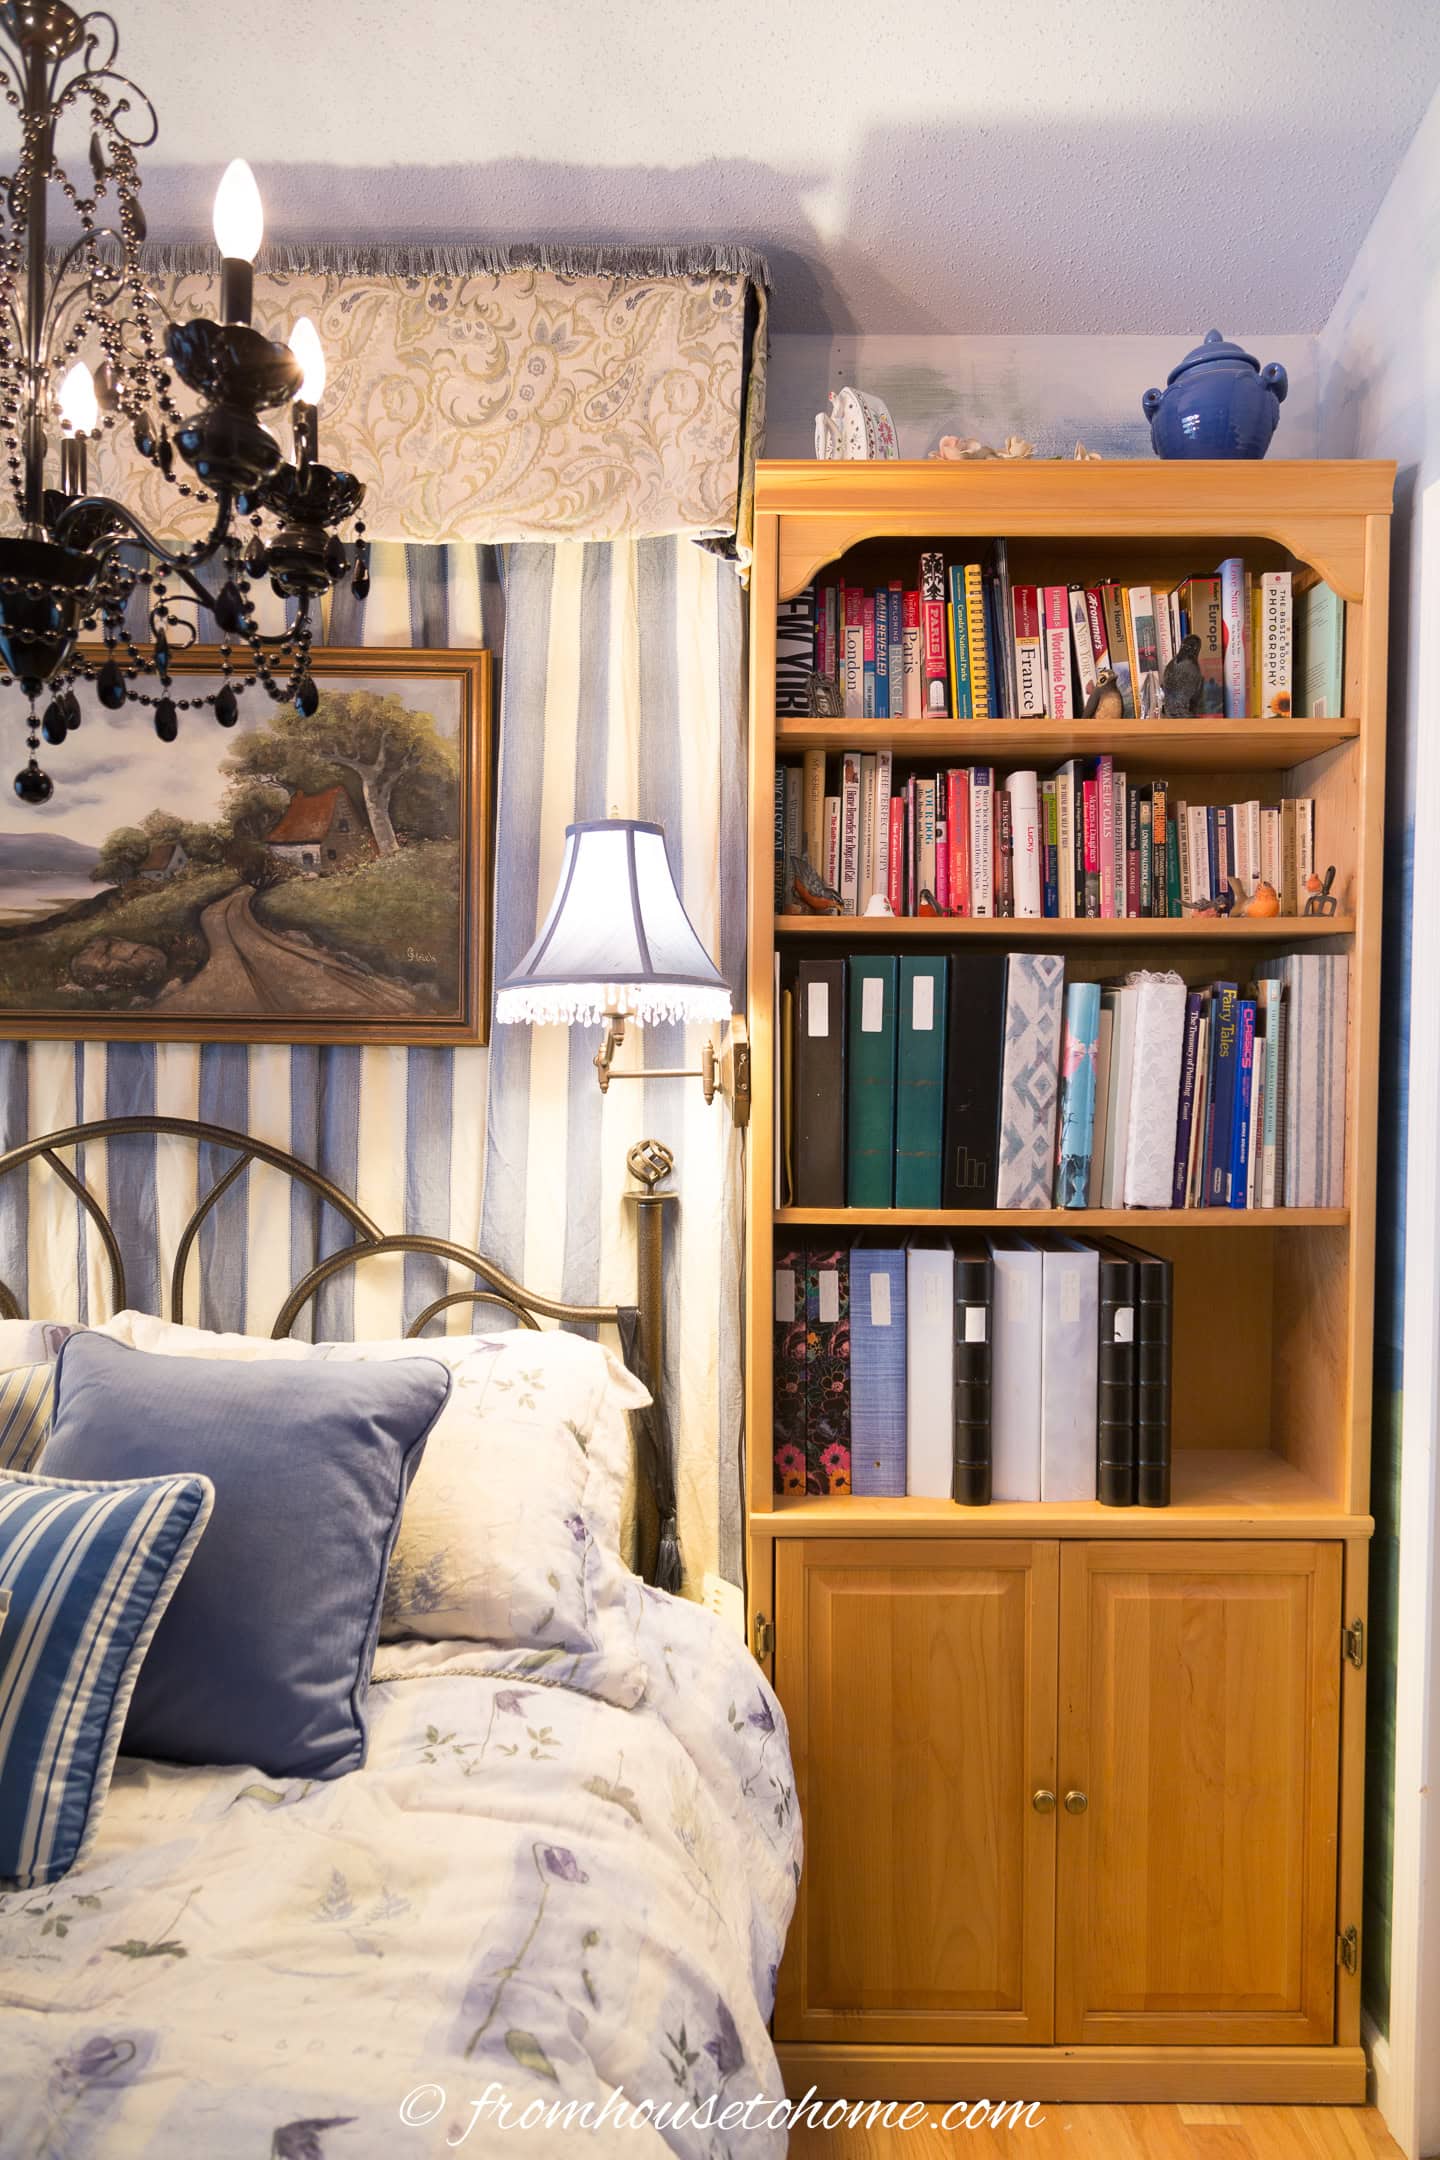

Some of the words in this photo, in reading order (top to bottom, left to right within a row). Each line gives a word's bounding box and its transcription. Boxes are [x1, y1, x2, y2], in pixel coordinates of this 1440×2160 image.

[1230, 564, 1241, 587] Love
[876, 592, 887, 622] MAUI
[1230, 590, 1241, 618] Smart
[1279, 590, 1287, 607] THE
[863, 608, 874, 650] Jamaica
[892, 594, 900, 642] EXPLORING
[930, 608, 941, 654] PARIS
[1088, 600, 1104, 650] Frommer's
[1207, 604, 1220, 652] Europe
[1279, 611, 1287, 642] BASIC
[876, 623, 887, 676] REVEALED
[1077, 624, 1089, 646] NEW
[1268, 588, 1278, 687] PHOTOGRAPHY
[846, 629, 860, 690] London
[903, 631, 919, 674] Paris
[1051, 631, 1064, 682] Worldwide
[1079, 649, 1092, 677] YORK
[1279, 645, 1287, 671] BOOK
[890, 647, 903, 704] FRANCE
[1021, 649, 1036, 710] France
[1053, 683, 1066, 719] Cruises
[880, 767, 890, 789] THE
[1102, 762, 1112, 806] WAKE-UP
[846, 790, 857, 807] Home
[925, 789, 934, 819] YOUR
[1088, 794, 1097, 820] Mothers
[845, 807, 857, 835] Remedies
[880, 792, 890, 837] PERFECT
[1103, 808, 1113, 838] CALLS
[1114, 803, 1123, 826] HIGHLY
[1153, 791, 1166, 844] SUPERLEARNING
[845, 835, 856, 844] for
[924, 821, 933, 846] DOG
[1087, 828, 1097, 864] Daughters
[1114, 827, 1123, 863] EFFECTIVE
[843, 844, 856, 858] Dogs
[844, 858, 856, 870] and
[879, 840, 889, 873] PUPPY
[844, 870, 855, 883] Cats
[1115, 863, 1123, 888] PEOPLE
[1190, 1011, 1199, 1025] The
[1217, 989, 1237, 1022] Fairy
[1186, 1025, 1198, 1057] Treasury
[1218, 1024, 1236, 1057] Tales
[1241, 1008, 1254, 1068] CLASSICS
[1186, 1058, 1195, 1066] of
[1183, 1066, 1194, 1097] Painting
[1182, 1102, 1190, 1121] Gaunt
[1175, 1162, 1185, 1191] Excalibur
